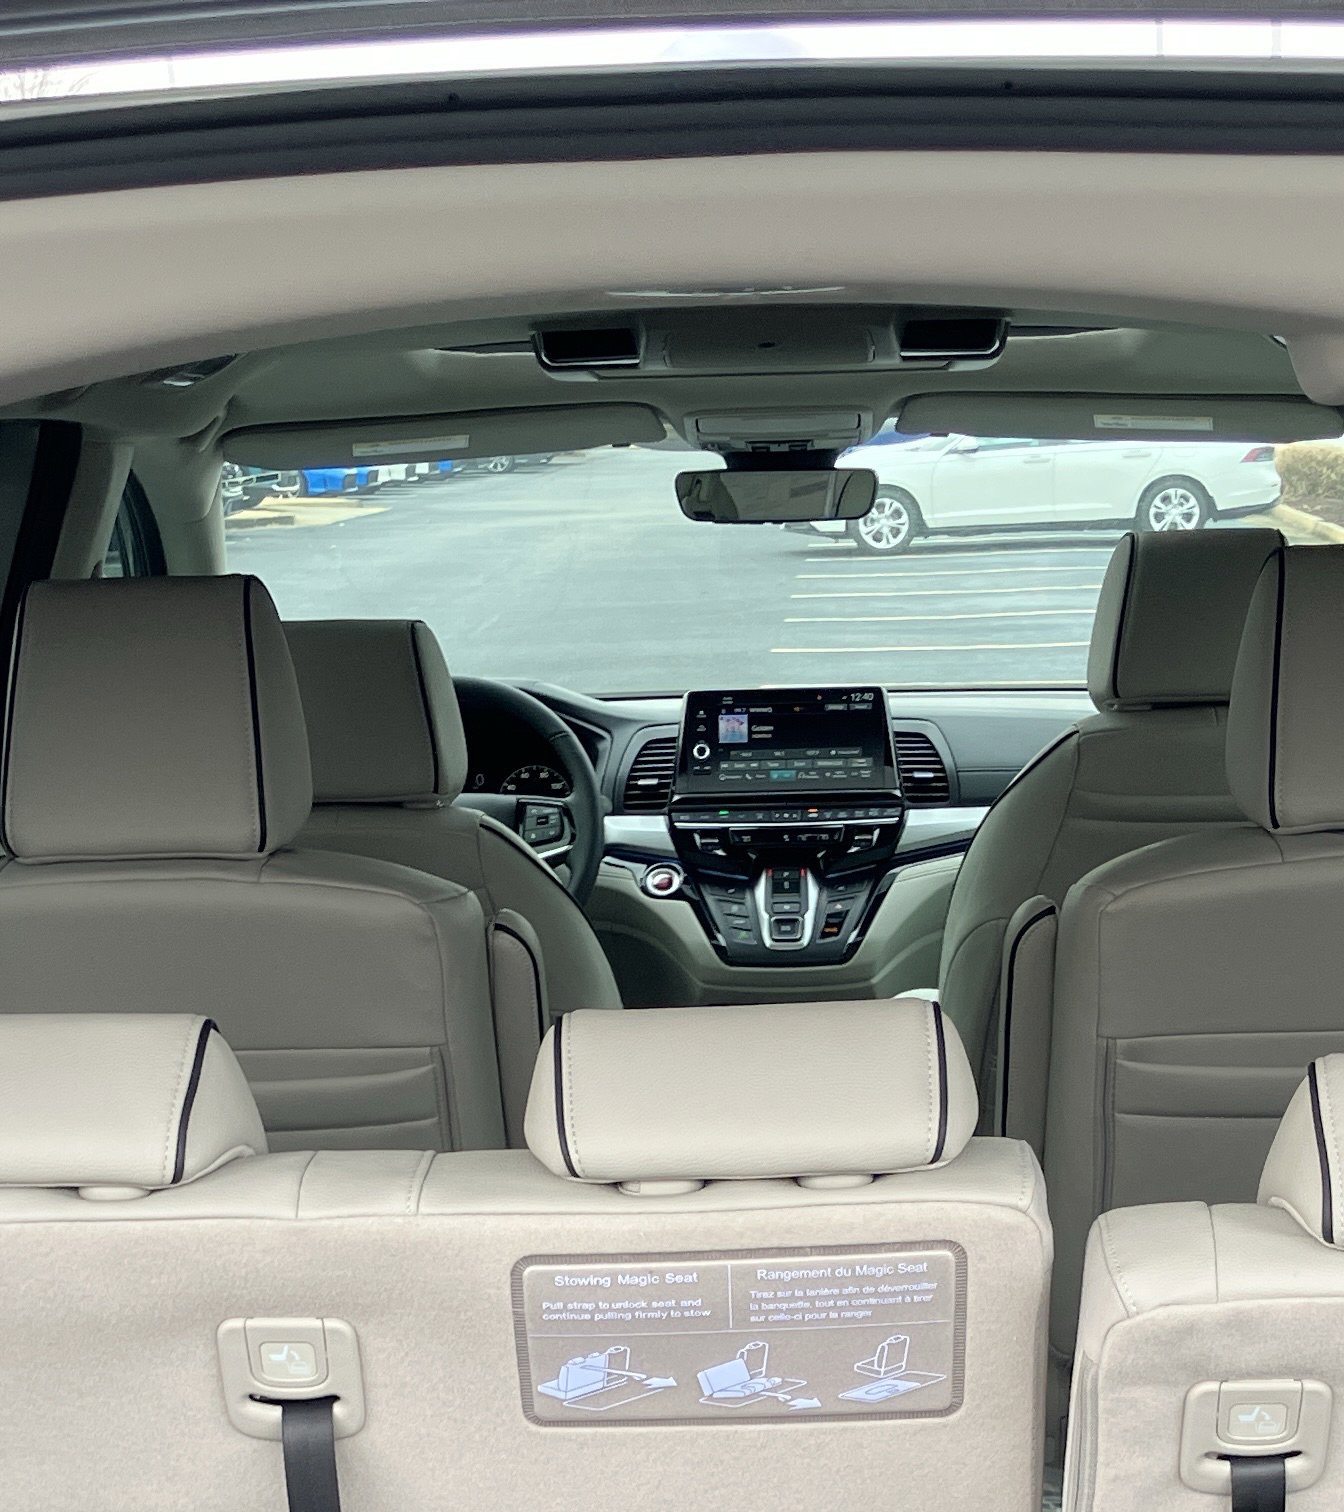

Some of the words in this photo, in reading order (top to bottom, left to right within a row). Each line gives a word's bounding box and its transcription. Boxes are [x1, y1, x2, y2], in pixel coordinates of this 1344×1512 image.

[756, 1266, 832, 1282] Rangement
[835, 1265, 852, 1278] du
[855, 1264, 894, 1279] Magic
[897, 1261, 928, 1274] Seat
[554, 1274, 611, 1288] Stowing
[617, 1273, 660, 1287] Magic
[665, 1271, 699, 1284] Seat
[777, 1290, 793, 1298] sur
[794, 1288, 804, 1297] la
[862, 1284, 875, 1294] de
[542, 1301, 563, 1311] Pull
[567, 1301, 595, 1312] strap
[598, 1300, 609, 1310] to
[611, 1299, 648, 1309] unlock
[651, 1299, 677, 1308] seat
[680, 1297, 702, 1307] and
[815, 1298, 834, 1308] tout
[837, 1299, 850, 1307] en
[851, 1295, 902, 1307] continuant
[542, 1311, 591, 1321] continue
[594, 1310, 632, 1321] pulling
[634, 1308, 668, 1320] firmly
[670, 1308, 682, 1318] to
[683, 1308, 712, 1317] stow
[750, 1313, 765, 1323] sur
[804, 1311, 827, 1323] pour
[840, 1308, 873, 1319] ranger
